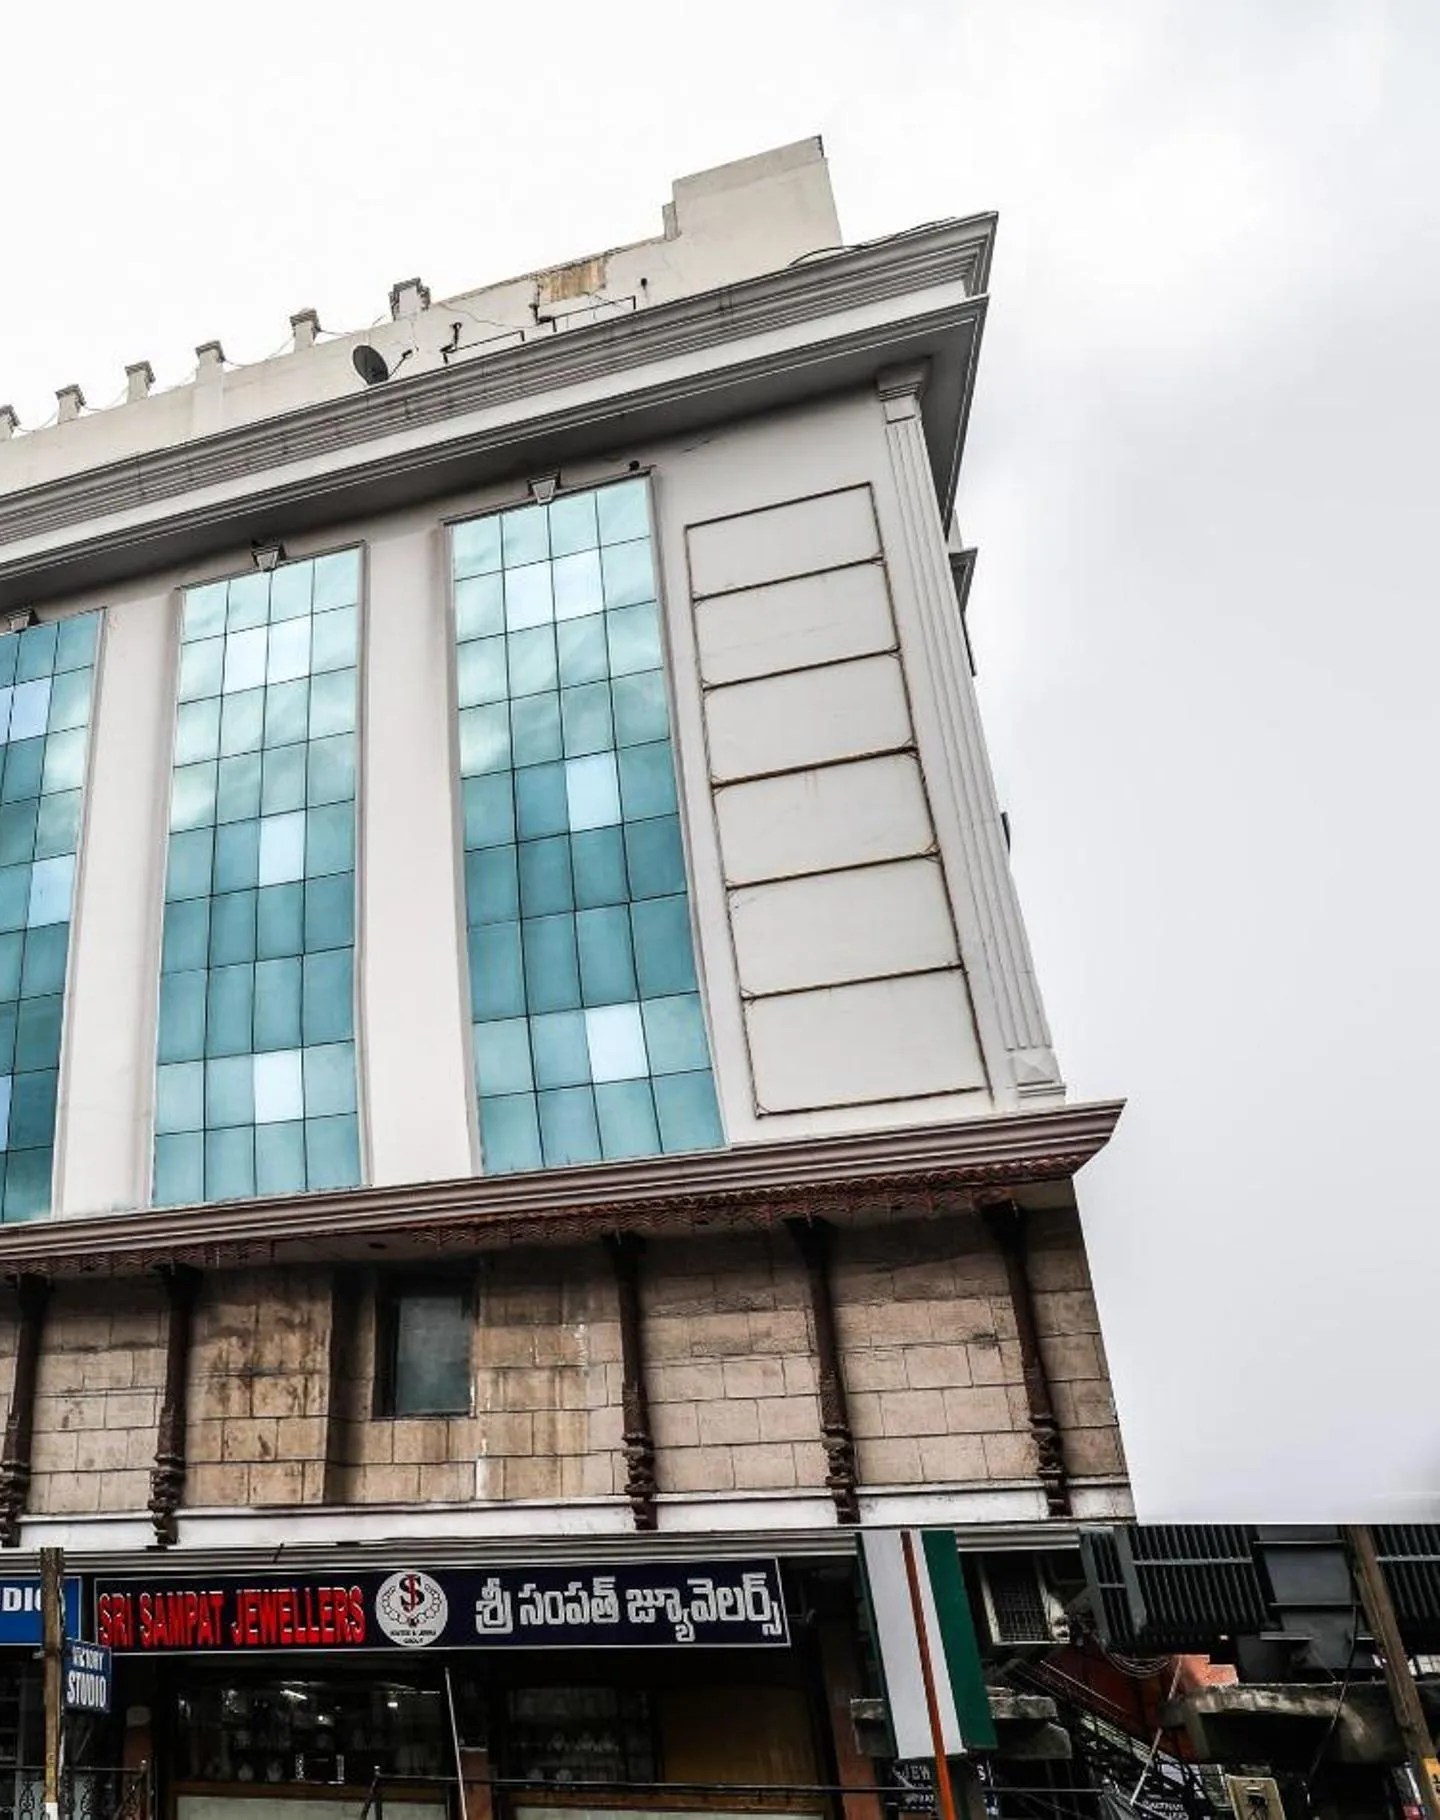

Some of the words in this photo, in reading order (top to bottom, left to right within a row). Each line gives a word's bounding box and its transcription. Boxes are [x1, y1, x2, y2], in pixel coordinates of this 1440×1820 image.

[99, 1592, 133, 1647] SRI
[140, 1590, 224, 1647] SAMPAT
[232, 1586, 366, 1645] JEWELLERS
[476, 1577, 513, 1634] శ్రీ
[518, 1576, 620, 1625] సంపత్
[67, 1669, 106, 1707] STUDIO
